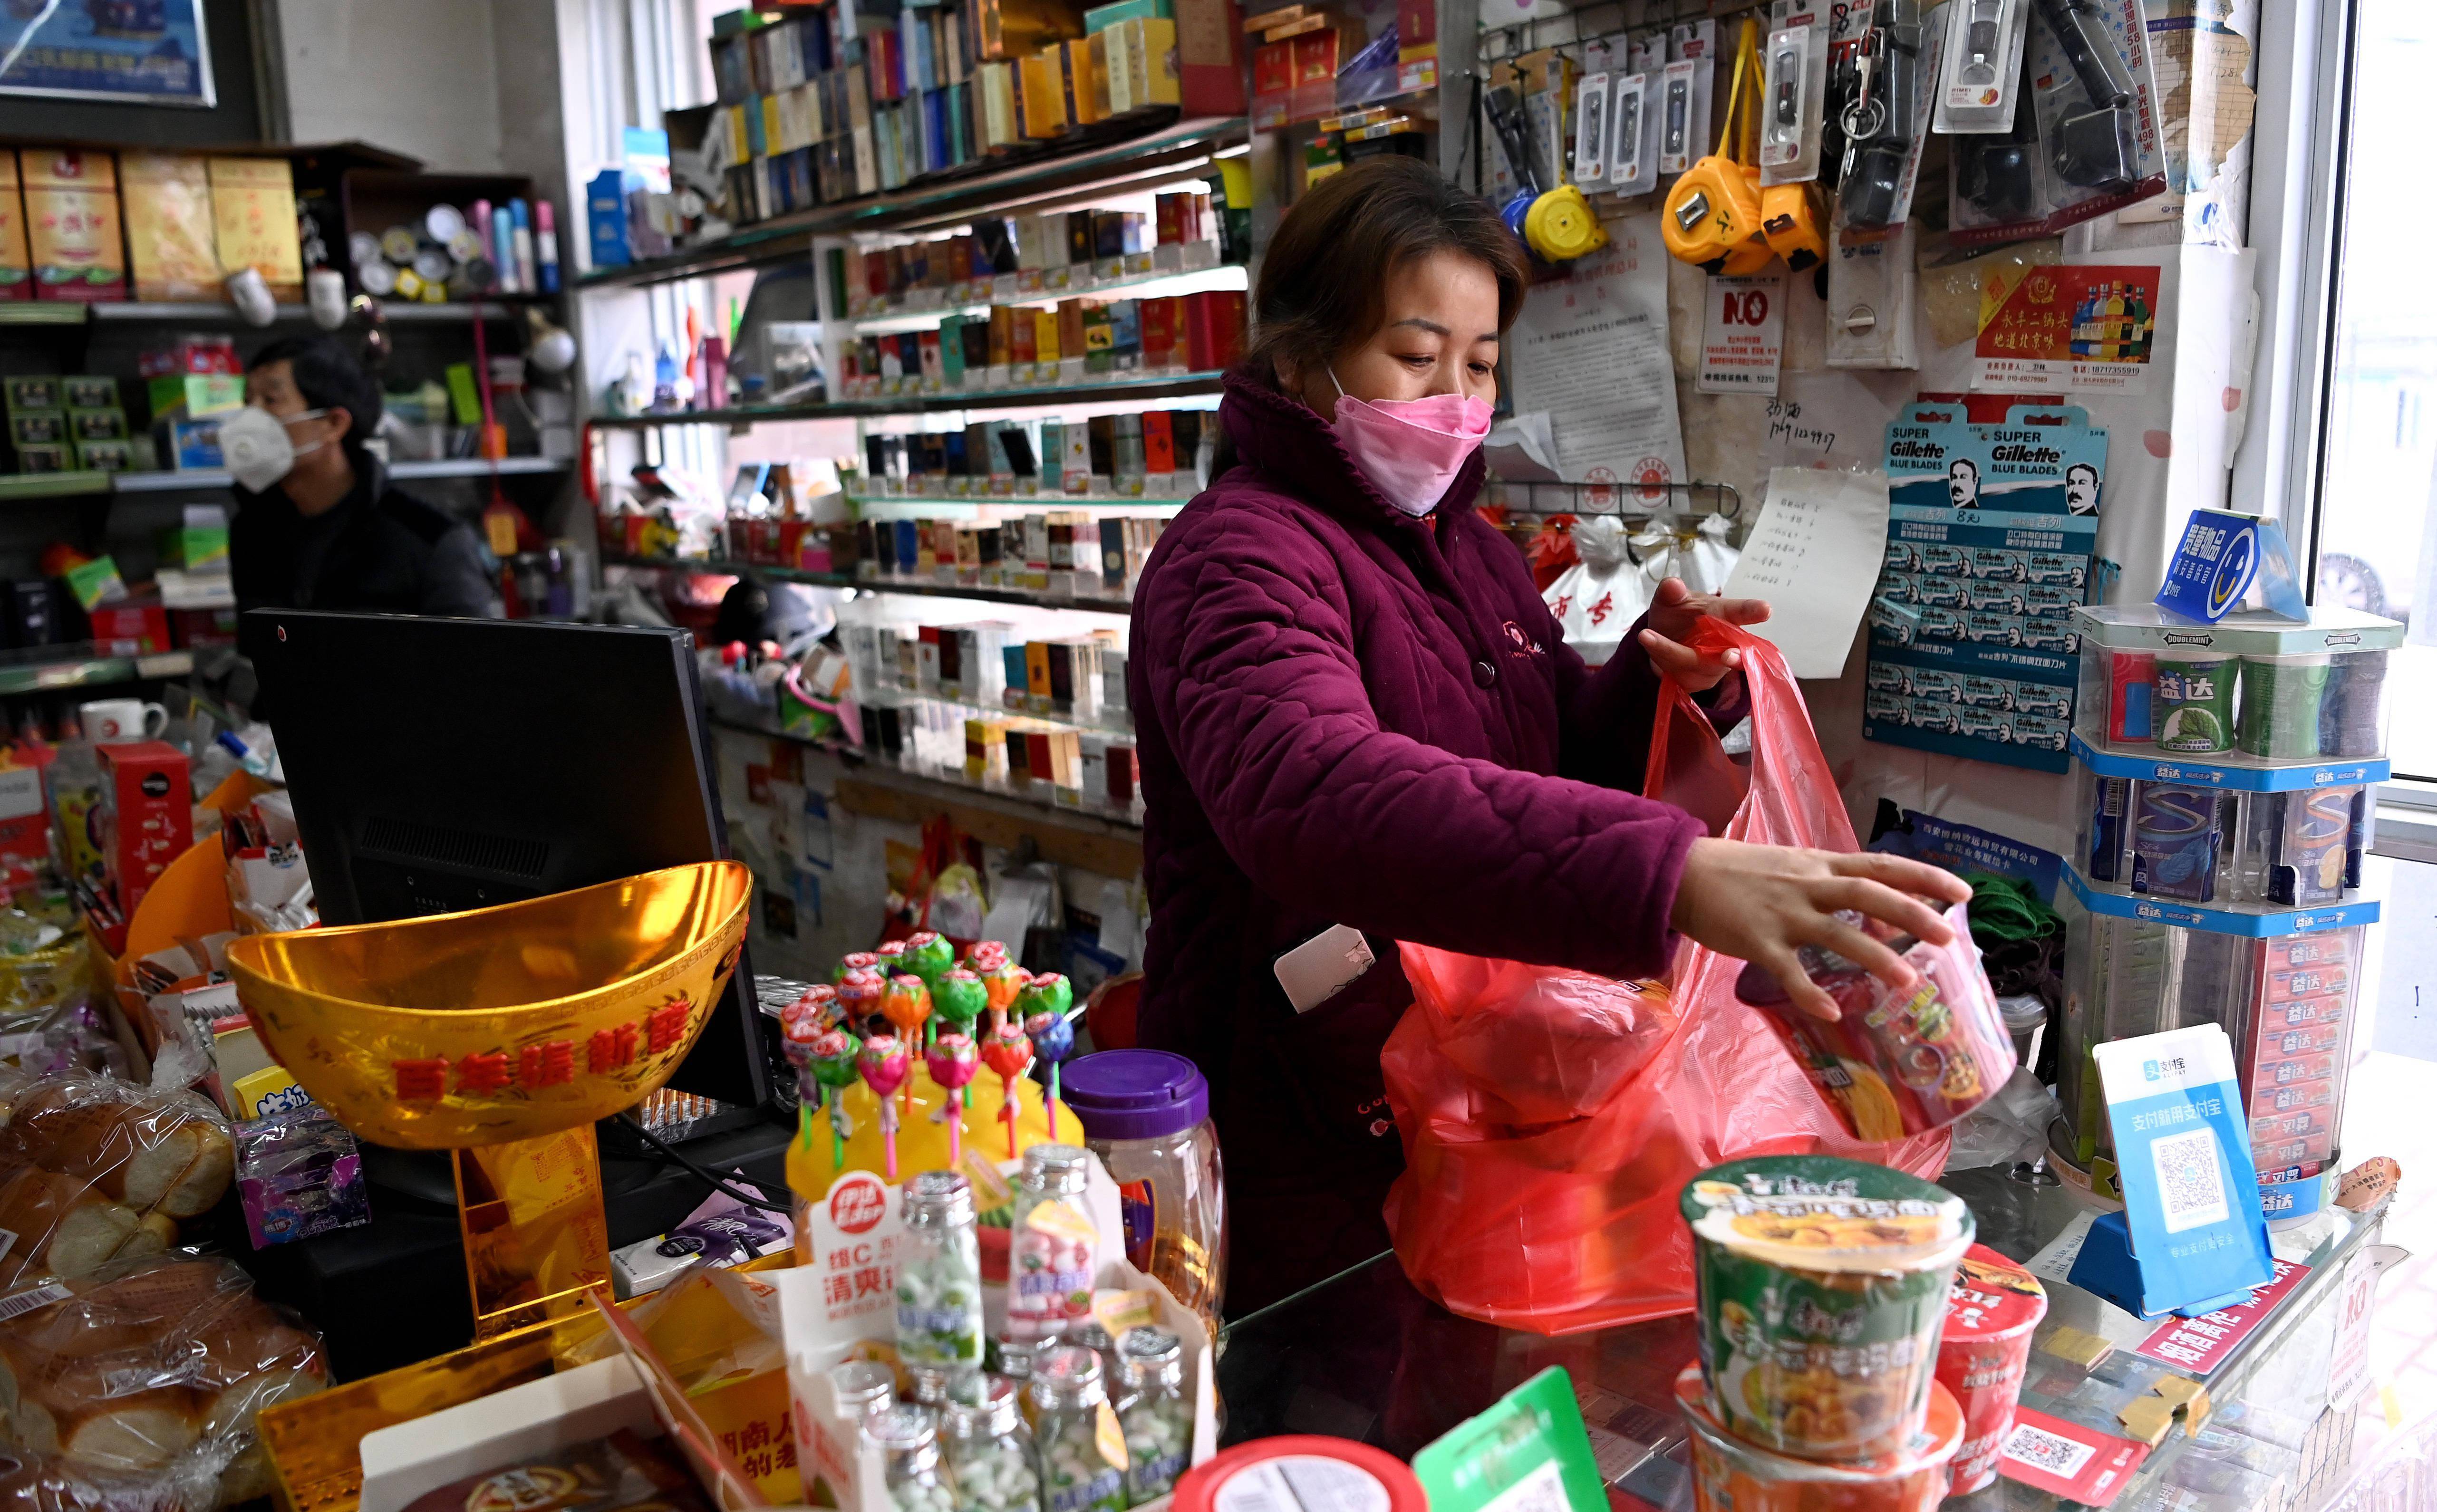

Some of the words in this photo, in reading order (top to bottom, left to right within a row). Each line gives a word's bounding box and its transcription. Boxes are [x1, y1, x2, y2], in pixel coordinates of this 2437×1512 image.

[1723, 290, 1768, 327] NO
[1994, 332, 2054, 350] 地道北京味
[1892, 428, 1929, 439] SUPER
[1994, 431, 2041, 443] SUPER
[1890, 441, 1944, 458] Gillette
[1992, 445, 2060, 463] Gillette
[1890, 459, 1908, 468] BLUE
[1911, 460, 1942, 470] BLADES
[1992, 464, 2015, 473] BLUE
[2019, 466, 2058, 475] BLADES
[2182, 524, 2226, 562] 贵重物品
[1976, 553, 2005, 562] Gillette
[2032, 557, 2063, 566] Gillette
[1974, 585, 2003, 594] Gillette
[2029, 589, 2060, 599] Gillette
[1972, 616, 2001, 626] Gillette
[2026, 622, 2057, 632] Gillette
[2167, 635, 2210, 645] DOUBLEMINT
[2327, 635, 2358, 645] DOUBLEMINT
[1966, 680, 1993, 690] Gillette
[2158, 677, 2214, 701] 益达
[2019, 687, 2050, 697] Gillette
[1964, 711, 1992, 721] Gillette
[2016, 719, 2046, 729] Gillette
[2157, 767, 2180, 779] 益达
[2314, 772, 2334, 783] 益达
[2137, 905, 2162, 918] 益达
[2296, 917, 2314, 927] 益达
[2291, 945, 2320, 963] 益达
[2292, 975, 2321, 992] 益达
[2287, 1004, 2316, 1022] 益达
[2282, 1033, 2311, 1051] 益达
[2160, 1058, 2186, 1072] 支付宝
[2163, 1069, 2186, 1079] ALIPAY
[2277, 1063, 2306, 1082] 益达
[2275, 1090, 2305, 1108] 益达
[2132, 1098, 2222, 1132] 支付就用支付宝
[2282, 1116, 2310, 1134] 益达
[2260, 1193, 2293, 1211] 益达
[2170, 1232, 2235, 1258] 专业支付更安全
